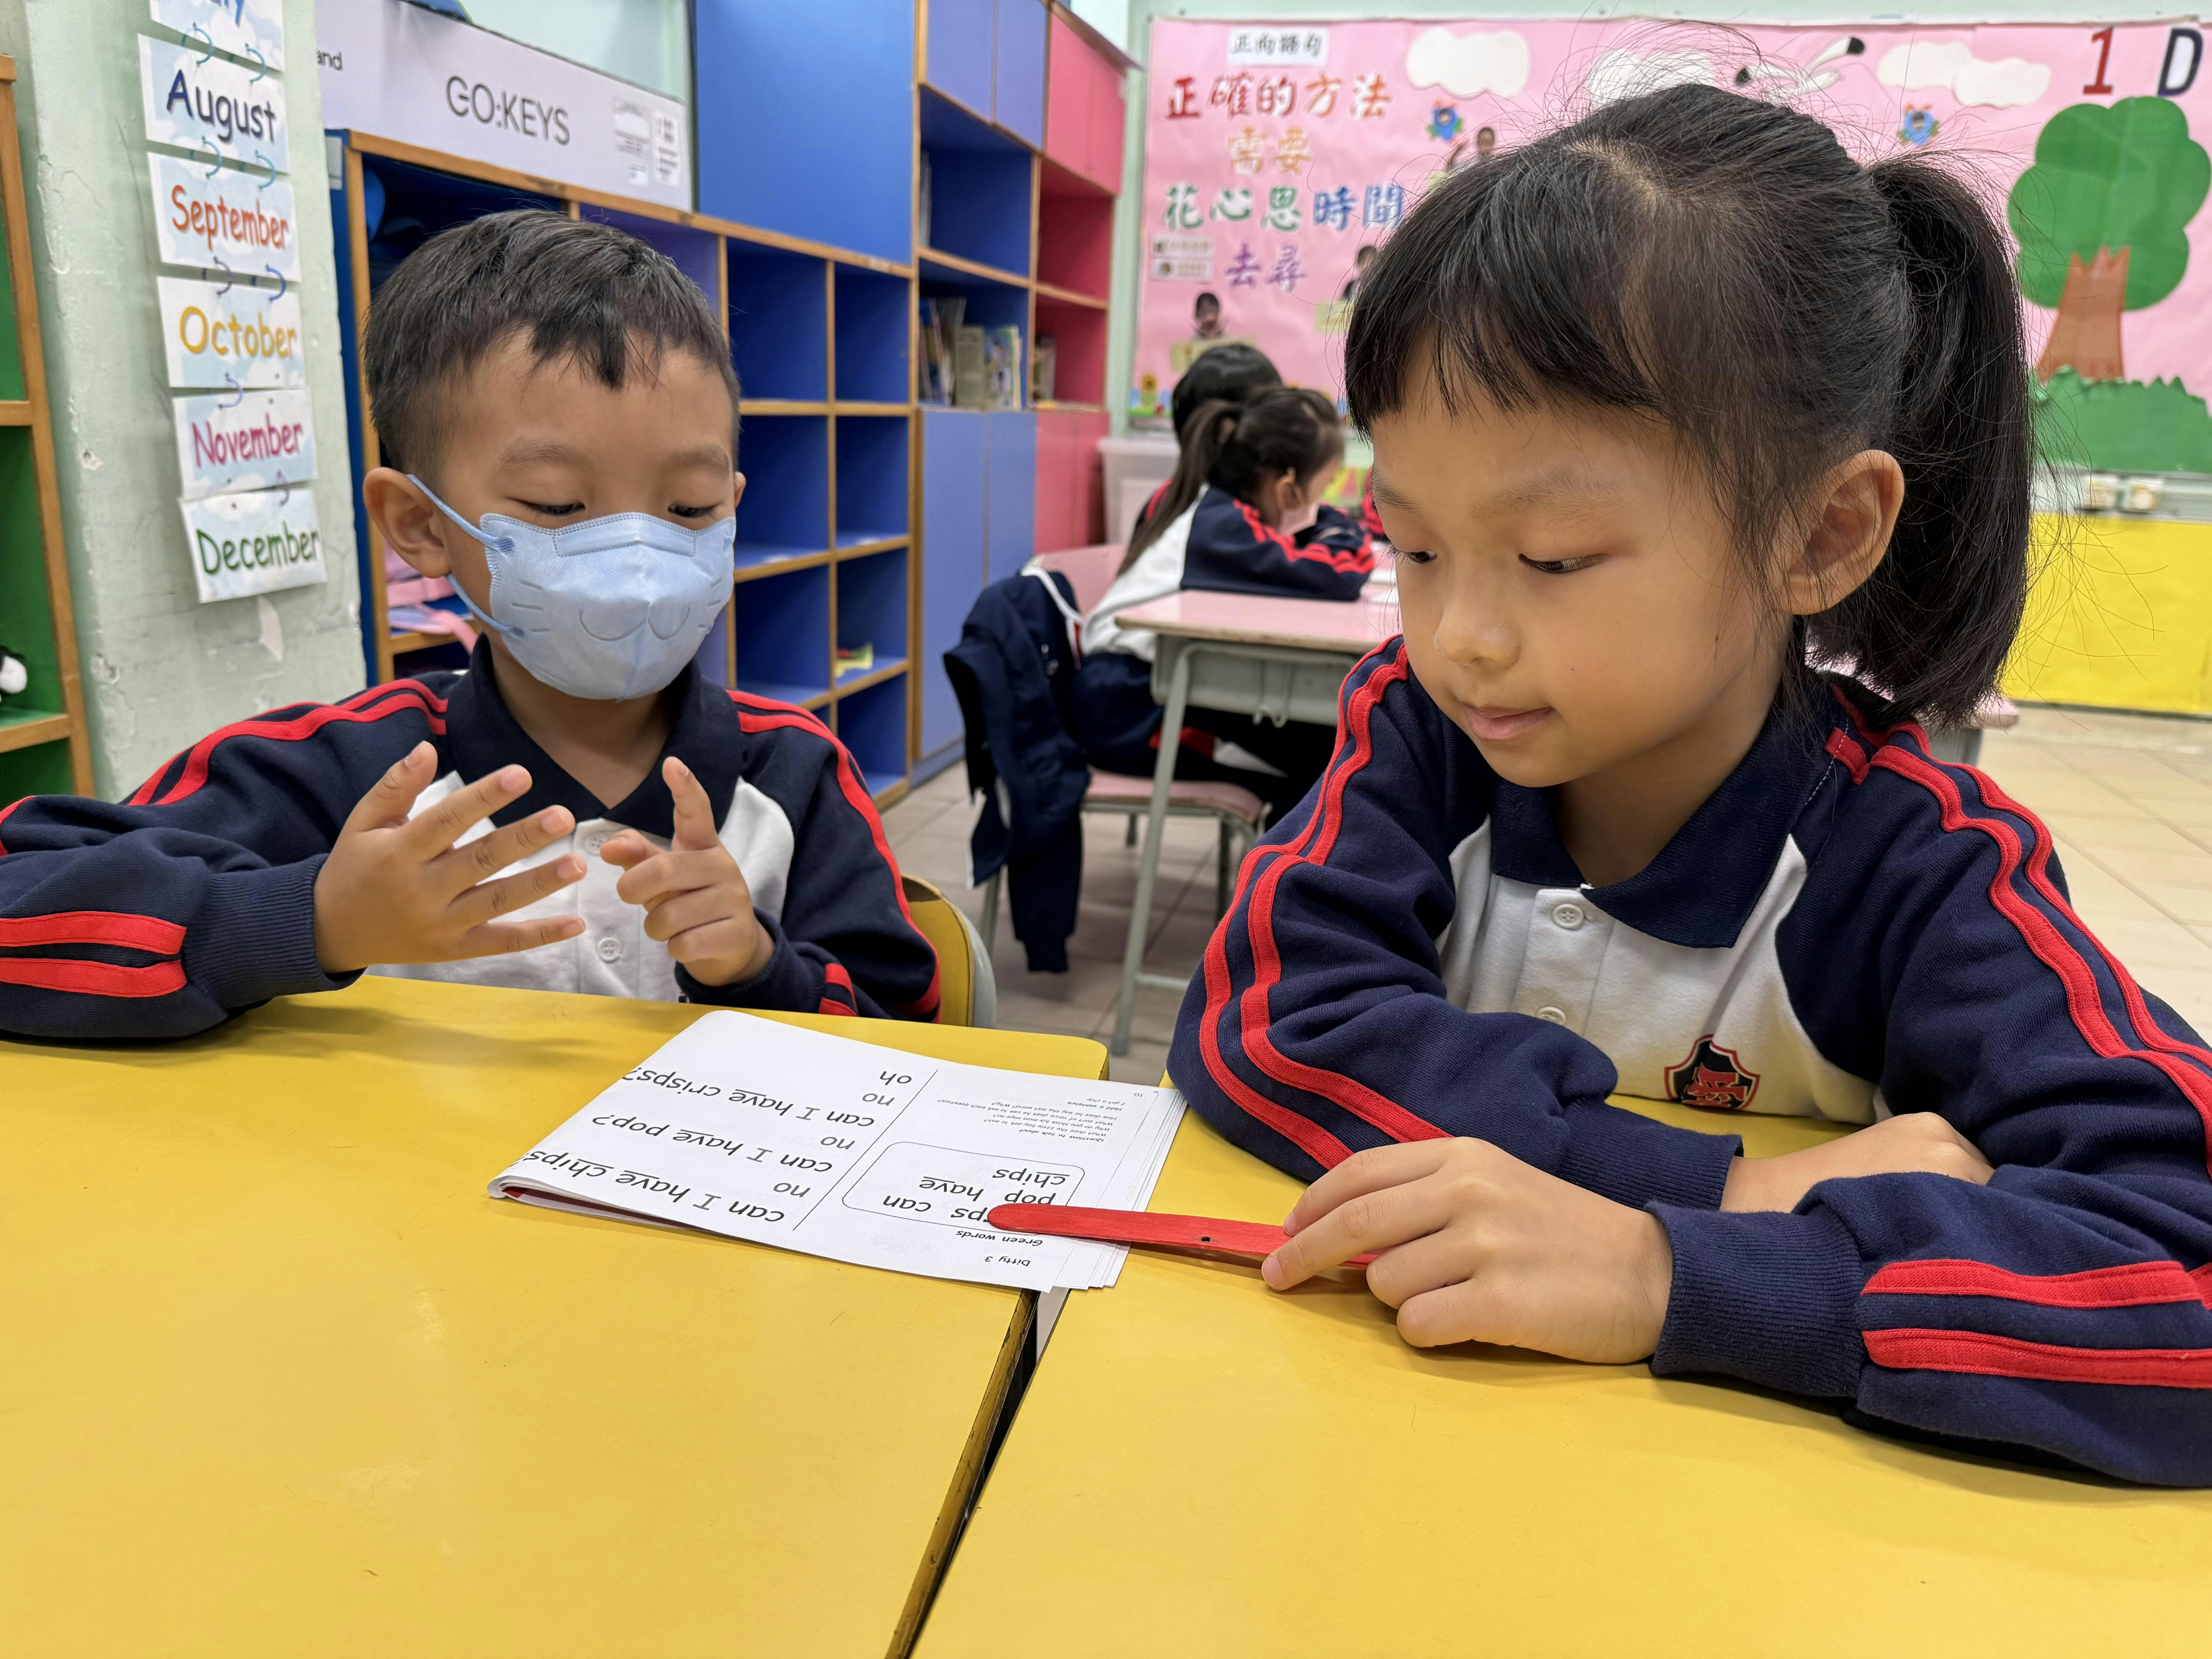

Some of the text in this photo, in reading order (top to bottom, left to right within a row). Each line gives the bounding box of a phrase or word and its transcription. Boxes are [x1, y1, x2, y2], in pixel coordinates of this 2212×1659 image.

[167, 69, 276, 144] August
[447, 76, 571, 146] GO:KEYS
[1166, 71, 1391, 120] 正確的方法
[1229, 126, 1310, 175] 需要
[172, 185, 290, 251] September
[1164, 183, 1404, 231] 花心思時間
[180, 306, 297, 358] October
[191, 413, 304, 468] November
[196, 519, 319, 575] December
[621, 1068, 875, 1127] can I have crisps?
[862, 1093, 895, 1106] no
[880, 1071, 912, 1085] oh
[592, 1115, 832, 1172] can I have pop?
[821, 1137, 855, 1150] no
[509, 1151, 785, 1222] can I have chips
[773, 1183, 811, 1197] no
[919, 1179, 1056, 1205] pop have
[992, 1168, 1066, 1188] chips
[883, 1195, 931, 1212] can
[956, 1231, 1043, 1247] Green words
[999, 1256, 1031, 1267] Ditty
